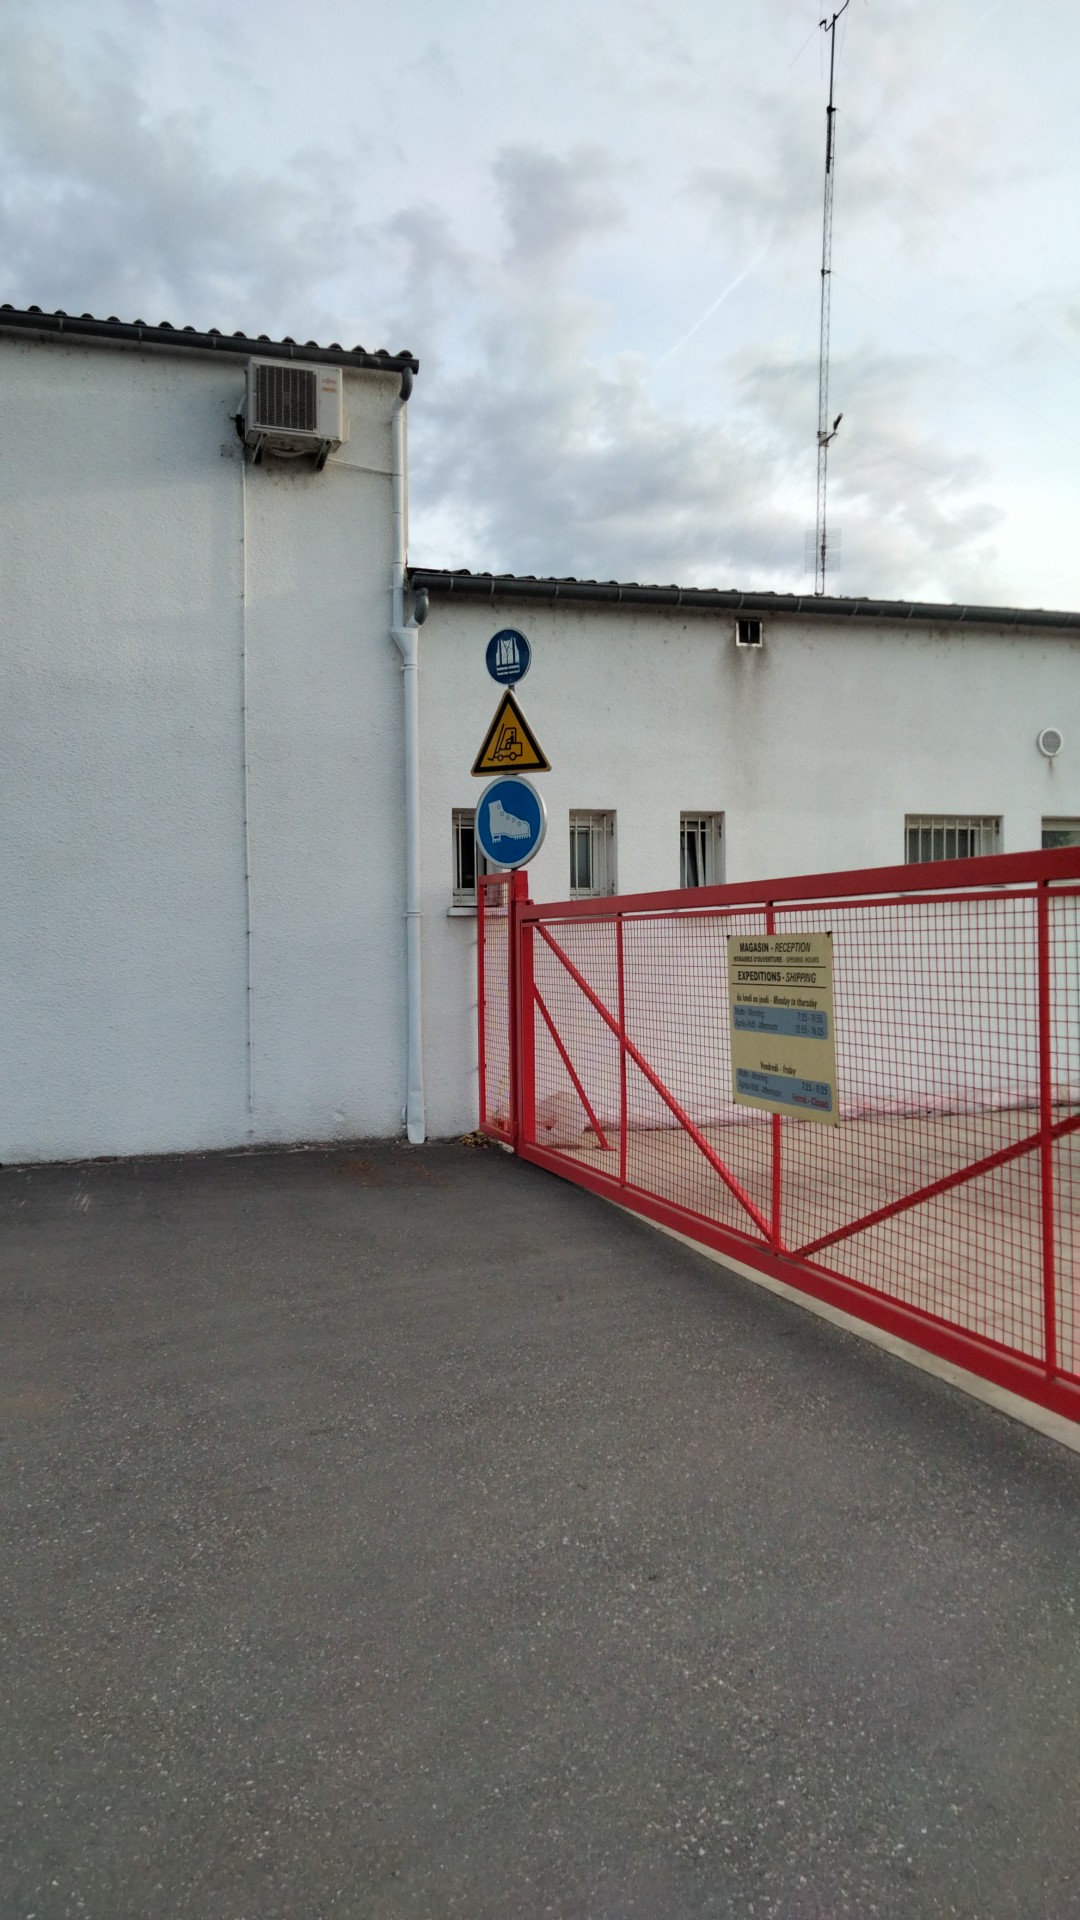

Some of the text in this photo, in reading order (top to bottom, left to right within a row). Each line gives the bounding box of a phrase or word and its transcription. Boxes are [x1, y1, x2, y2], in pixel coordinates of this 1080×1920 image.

[740, 942, 769, 952] MAGASIN
[774, 942, 812, 952] RECEPTION
[738, 971, 781, 982] EXPEDITIONS
[785, 972, 816, 983] SHIPPING
[742, 993, 752, 1002] lundi
[759, 995, 769, 1005] jeudi
[773, 996, 790, 1007] Monday
[791, 998, 796, 1006] to
[797, 998, 818, 1010] thursday
[760, 1061, 779, 1072] Vendredi
[811, 1097, 829, 1108] Closed
